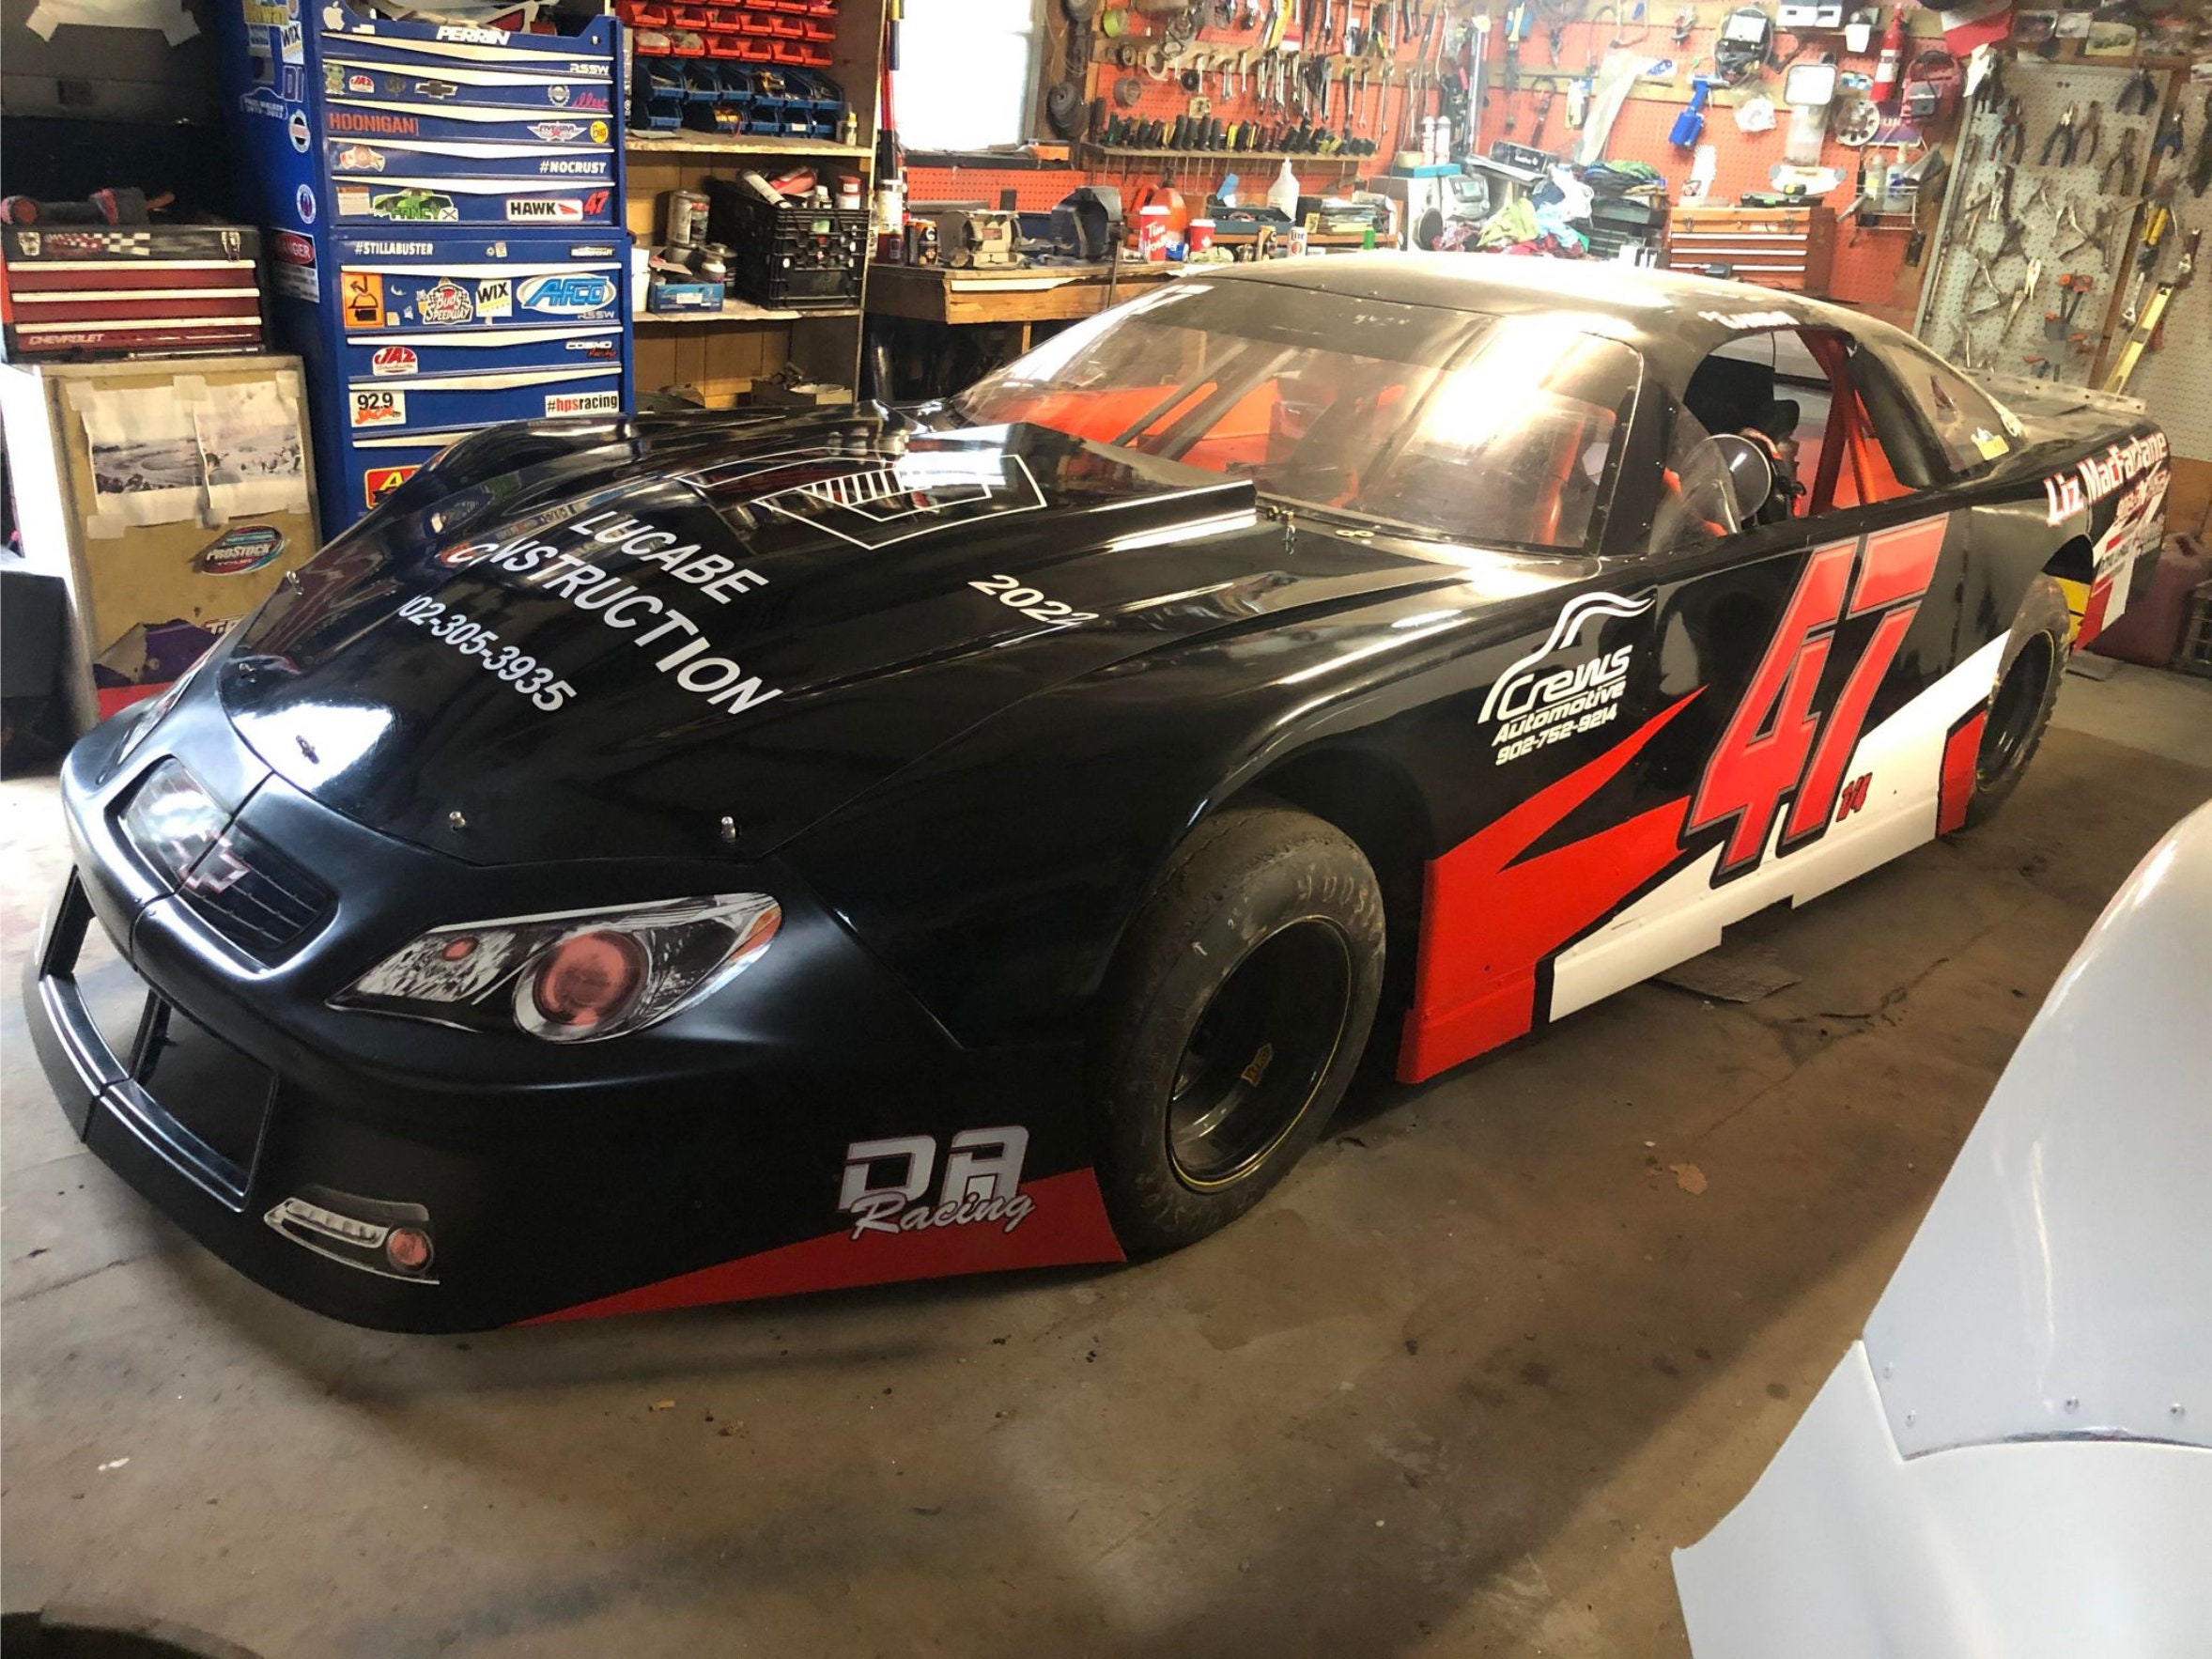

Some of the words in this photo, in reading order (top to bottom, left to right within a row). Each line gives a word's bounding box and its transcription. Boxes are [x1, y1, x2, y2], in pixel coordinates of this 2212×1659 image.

[436, 25, 511, 45] PERRIN
[539, 161, 606, 174] #NOCRUST
[510, 202, 557, 215] HAWK
[583, 190, 610, 216] 47
[355, 241, 434, 256] #STILLABUSTER
[477, 282, 509, 303] WIX
[524, 278, 608, 306] AFCO
[29, 333, 105, 346] CHEVROLET
[374, 347, 416, 364] JAZ
[357, 392, 394, 411] 92.9
[547, 395, 618, 413] #hpsracing
[2043, 472, 2085, 528] Liz
[568, 510, 770, 604] LUCABE
[967, 574, 1100, 627] 2022
[447, 537, 783, 715] CNSTRUCTION
[398, 594, 578, 712] 02-305-3935
[1496, 644, 1633, 721] Crews
[1684, 512, 1951, 883] 47
[1491, 680, 1627, 747] Automotive
[1495, 703, 1618, 766] 902-752-9214
[838, 1125, 1030, 1211] DA
[849, 1190, 1037, 1241] Racing
